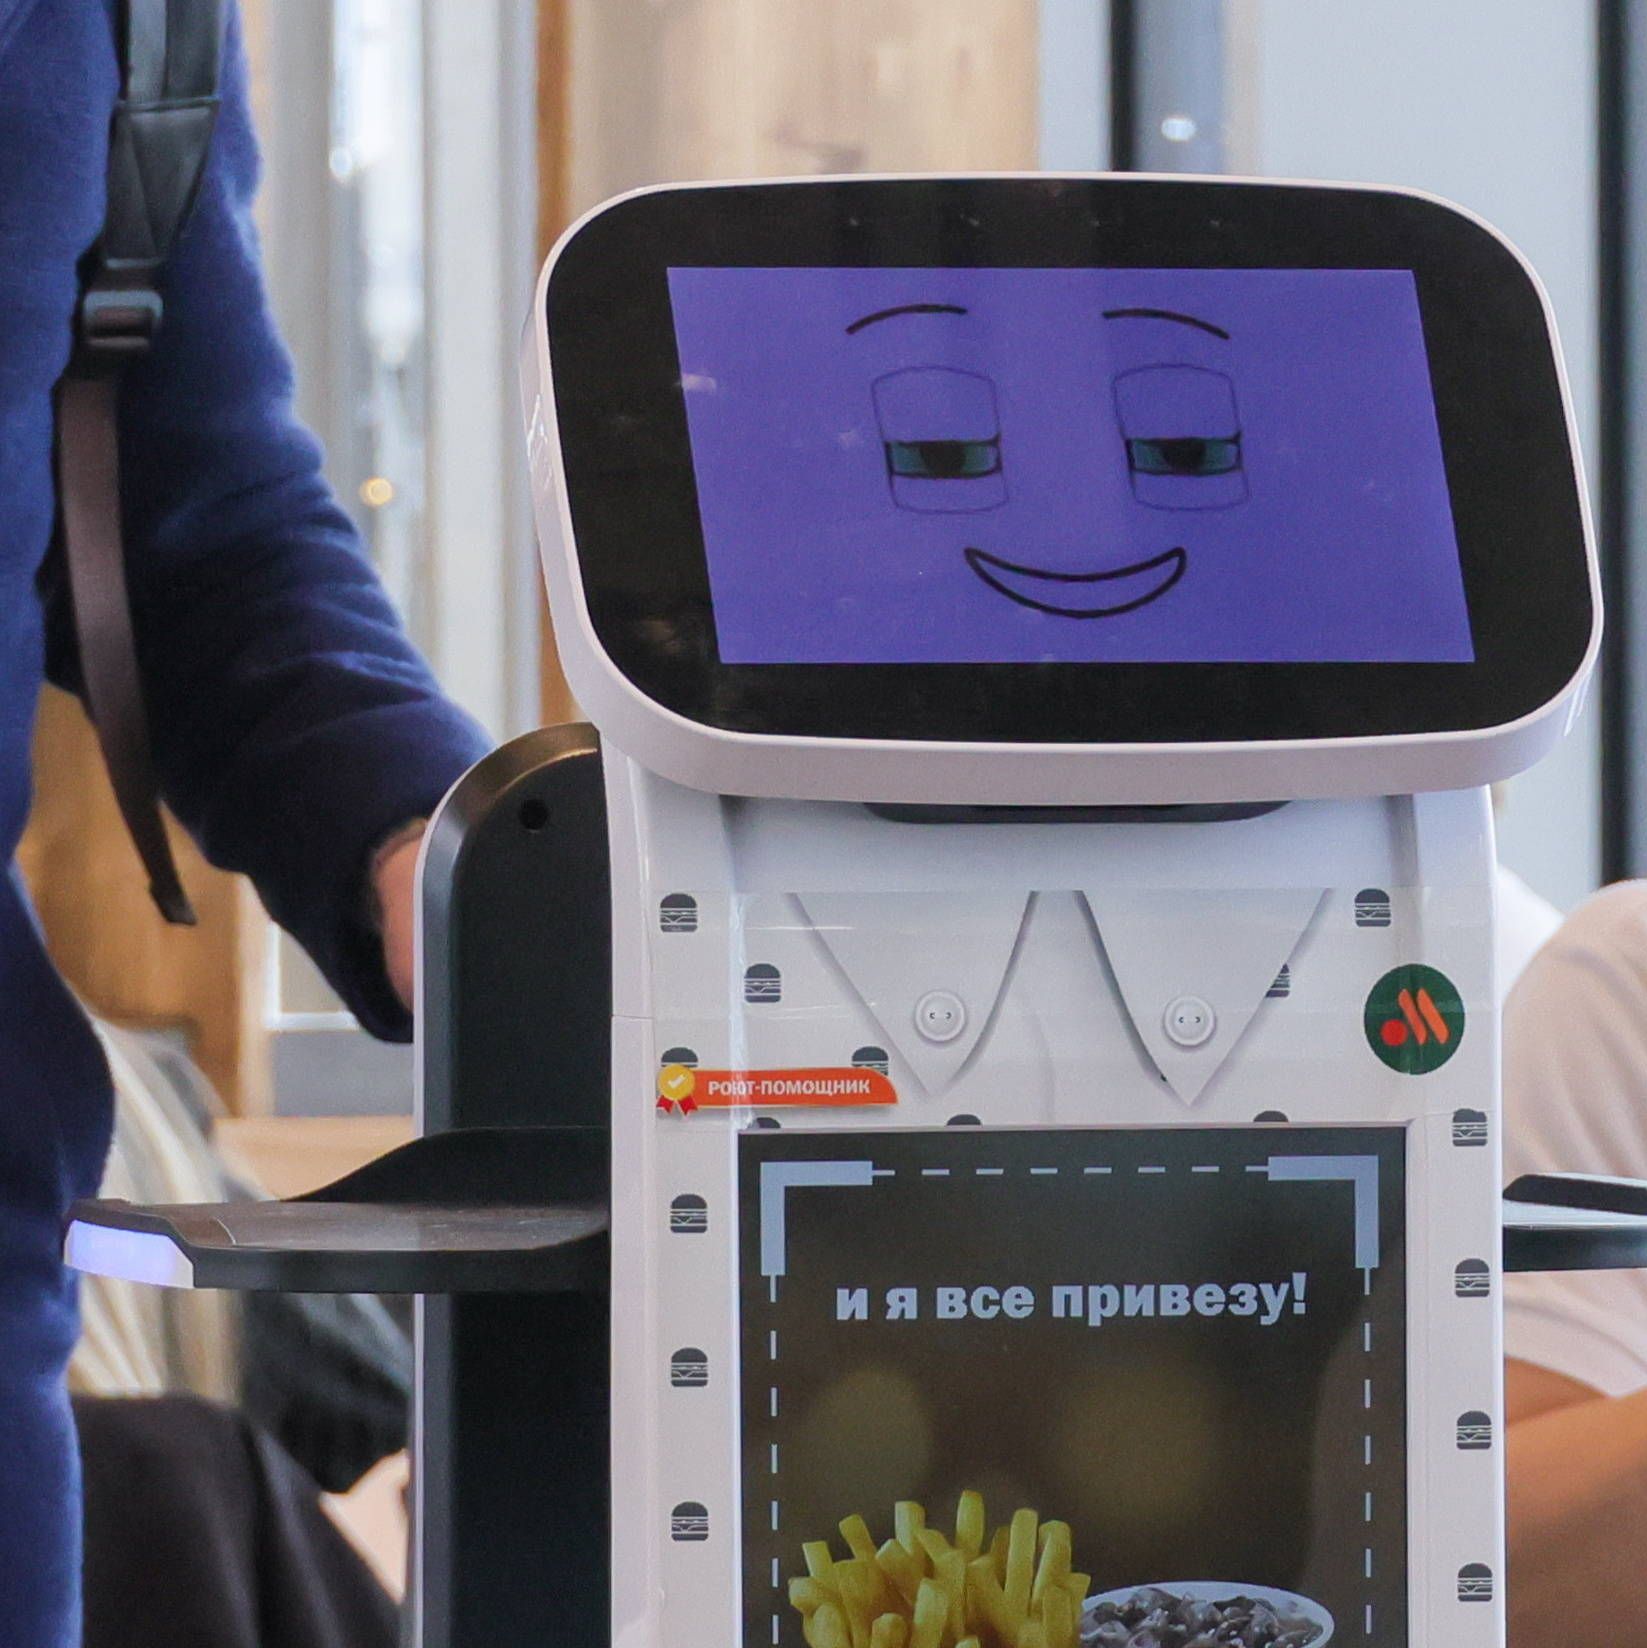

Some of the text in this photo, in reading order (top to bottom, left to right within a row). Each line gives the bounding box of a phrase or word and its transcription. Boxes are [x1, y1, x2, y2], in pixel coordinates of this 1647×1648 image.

[836, 1272, 1307, 1327] и я все привезу!
